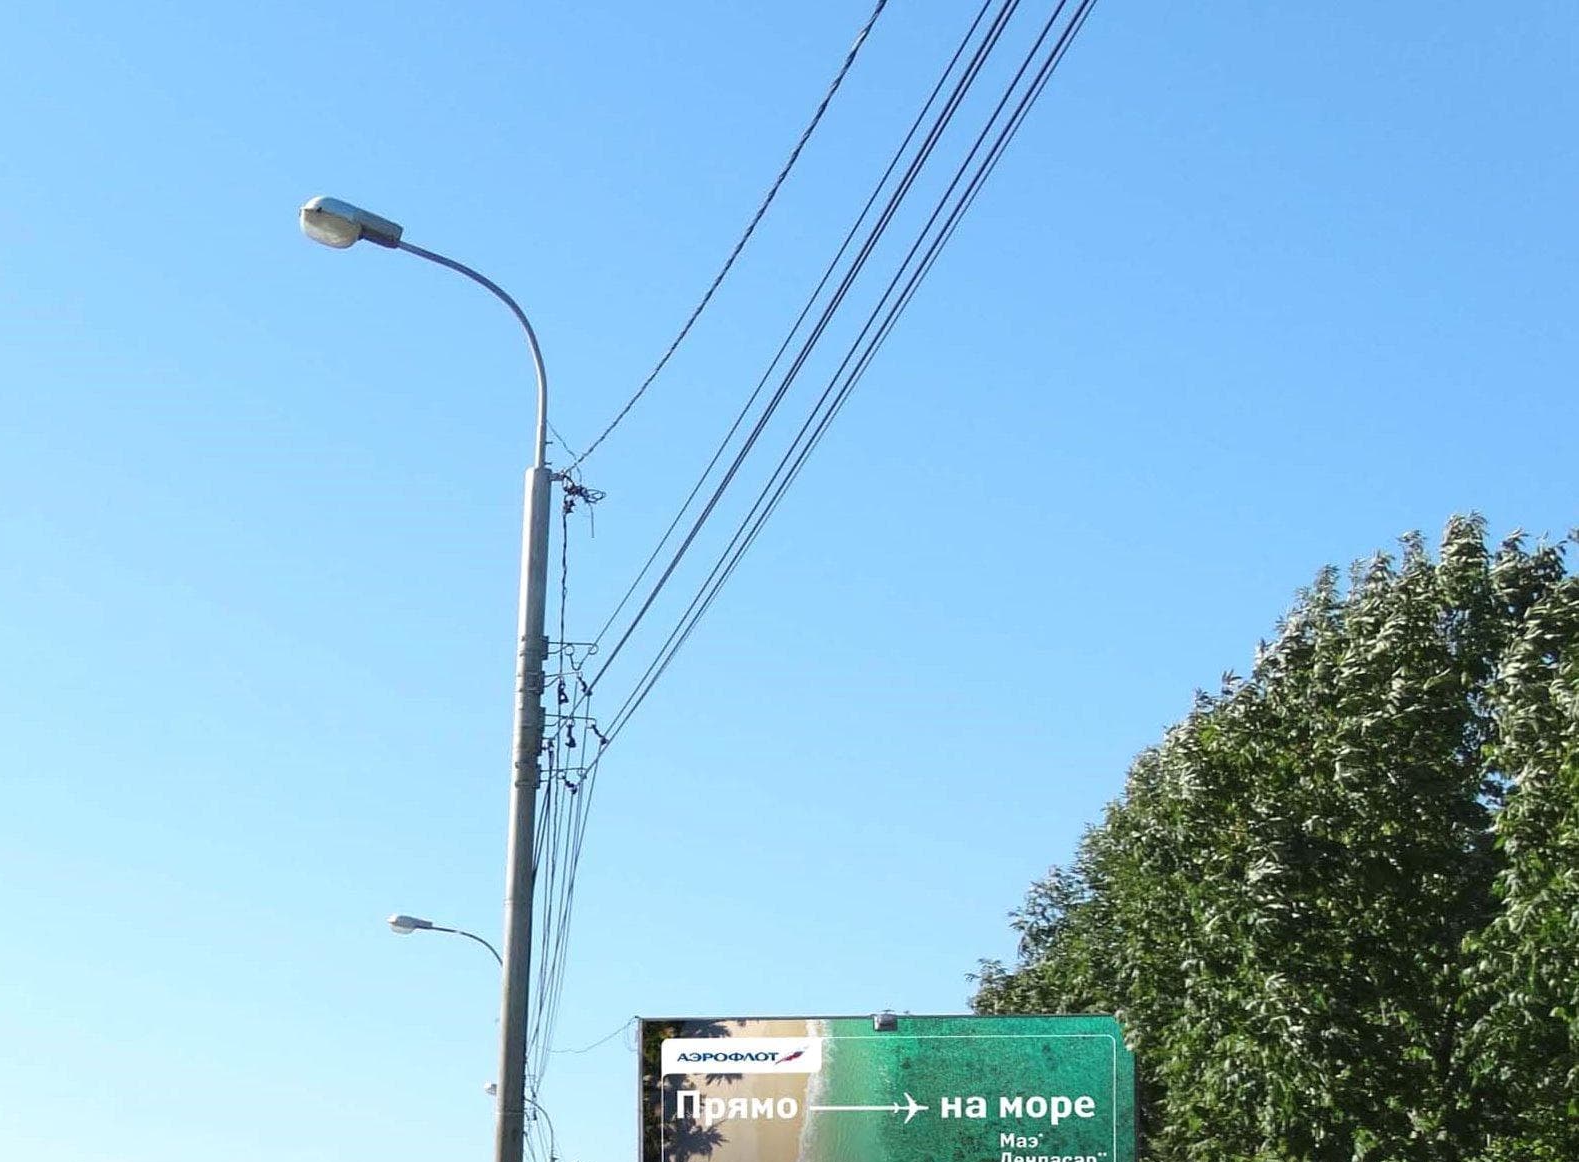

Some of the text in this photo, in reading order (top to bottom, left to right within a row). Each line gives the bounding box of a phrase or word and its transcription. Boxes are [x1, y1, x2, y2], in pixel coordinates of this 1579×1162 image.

[677, 1052, 779, 1062] АЭРОФЛОТ
[676, 1090, 1095, 1126] Прямо на море
